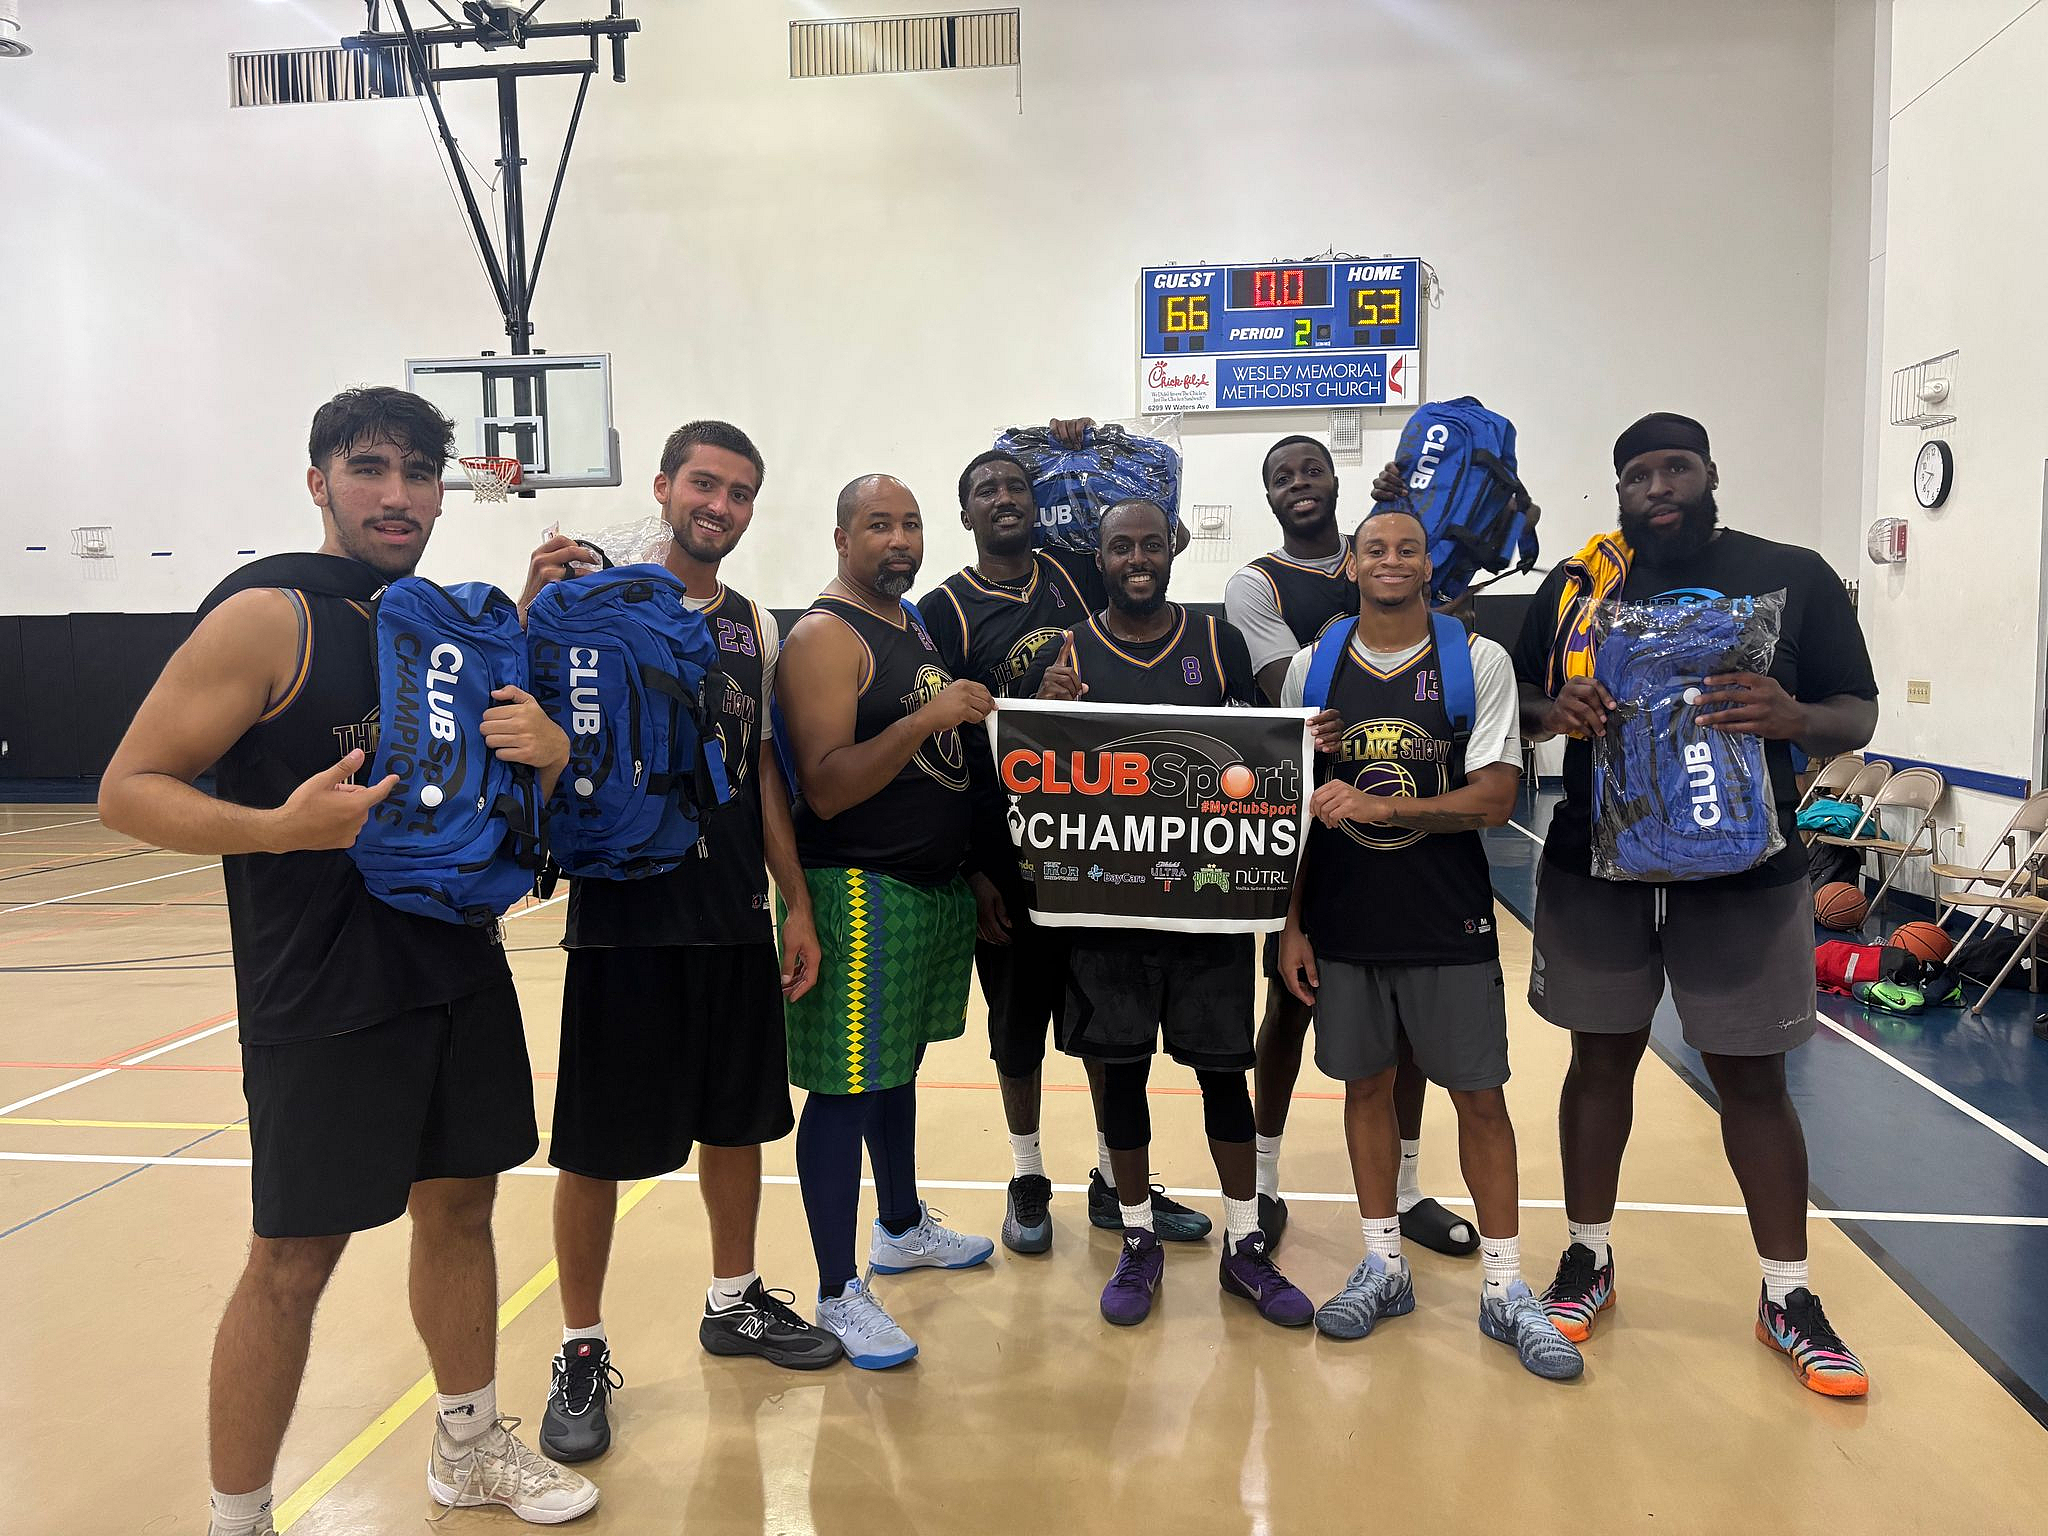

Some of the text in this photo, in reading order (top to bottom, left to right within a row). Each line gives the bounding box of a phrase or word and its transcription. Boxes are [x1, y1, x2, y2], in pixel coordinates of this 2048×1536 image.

[1153, 272, 1215, 289] GUEST
[1347, 265, 1404, 282] HOME
[1254, 270, 1304, 307] 0.0
[1167, 295, 1209, 332] 66
[1357, 288, 1401, 325] 53
[1229, 327, 1284, 341] PERIOD
[1295, 319, 1311, 346] 2
[1232, 361, 1381, 382] WESLEY MEMORIAL
[1222, 380, 1381, 400] METHODIST CHURCH
[716, 617, 757, 657] 23
[1181, 655, 1203, 686] 8
[722, 688, 756, 724] HOW
[1354, 738, 1398, 760] LAKE
[1200, 800, 1298, 817] #MyClubSport
[1027, 811, 1298, 857] CHAMPIONS
[1103, 871, 1146, 885] BayCare
[1150, 867, 1188, 877] ULTRA
